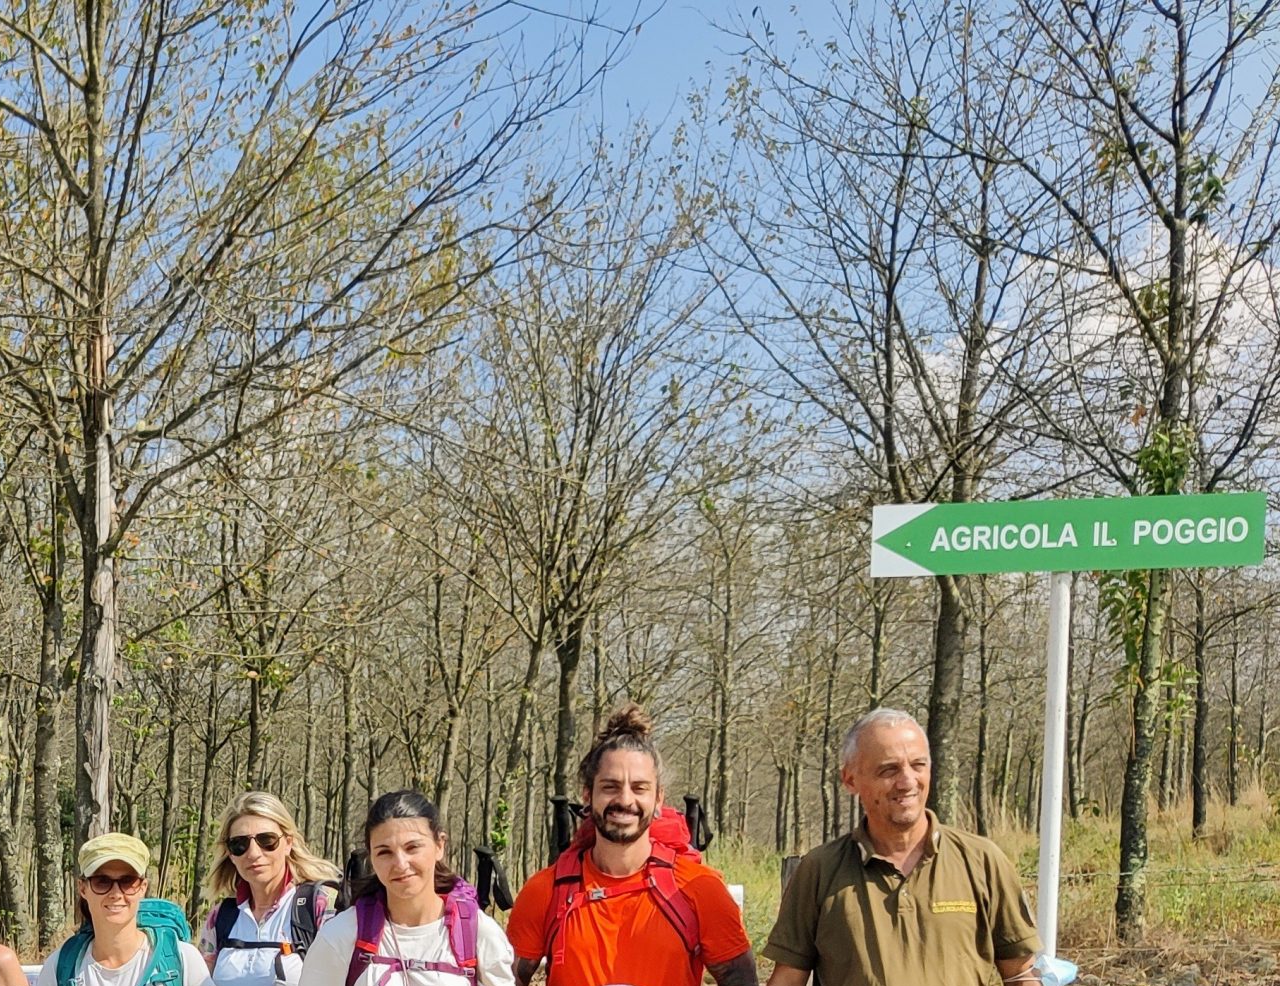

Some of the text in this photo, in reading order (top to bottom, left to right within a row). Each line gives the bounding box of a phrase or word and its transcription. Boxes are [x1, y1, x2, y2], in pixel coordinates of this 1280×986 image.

[930, 516, 1249, 552] AGRICOLA IL POGGIO
